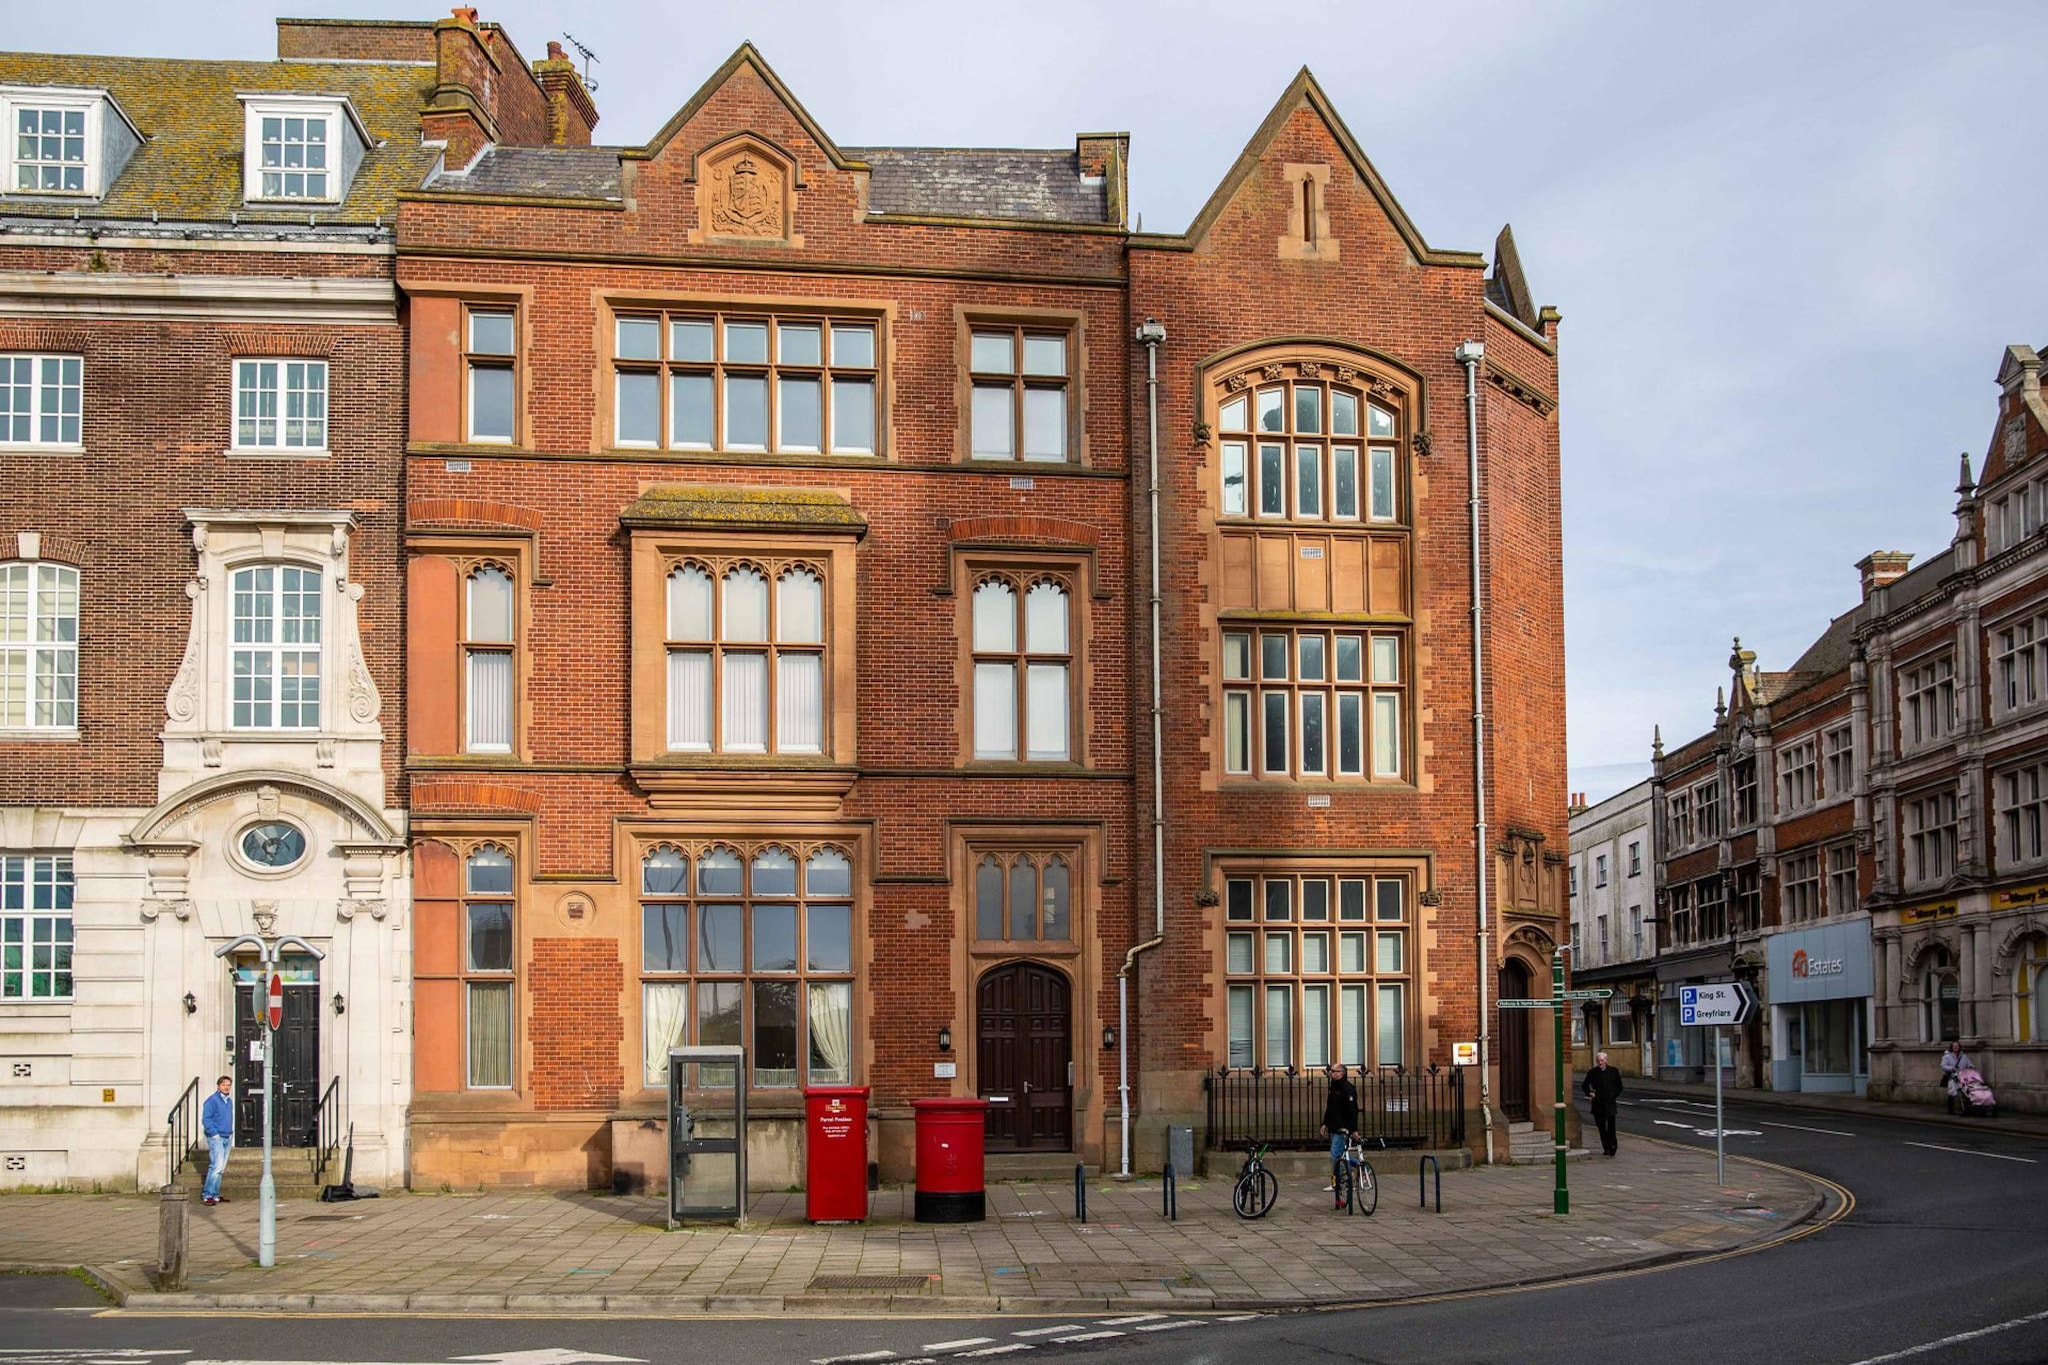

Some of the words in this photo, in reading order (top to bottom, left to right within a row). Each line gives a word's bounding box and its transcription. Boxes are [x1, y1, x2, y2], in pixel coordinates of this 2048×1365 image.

[1808, 959, 1842, 976] Estates
[1684, 990, 1692, 1004] P
[1699, 991, 1714, 1000] King
[1715, 990, 1726, 999] St.
[1685, 1008, 1693, 1022] P
[1696, 1009, 1731, 1018] Greyfriars
